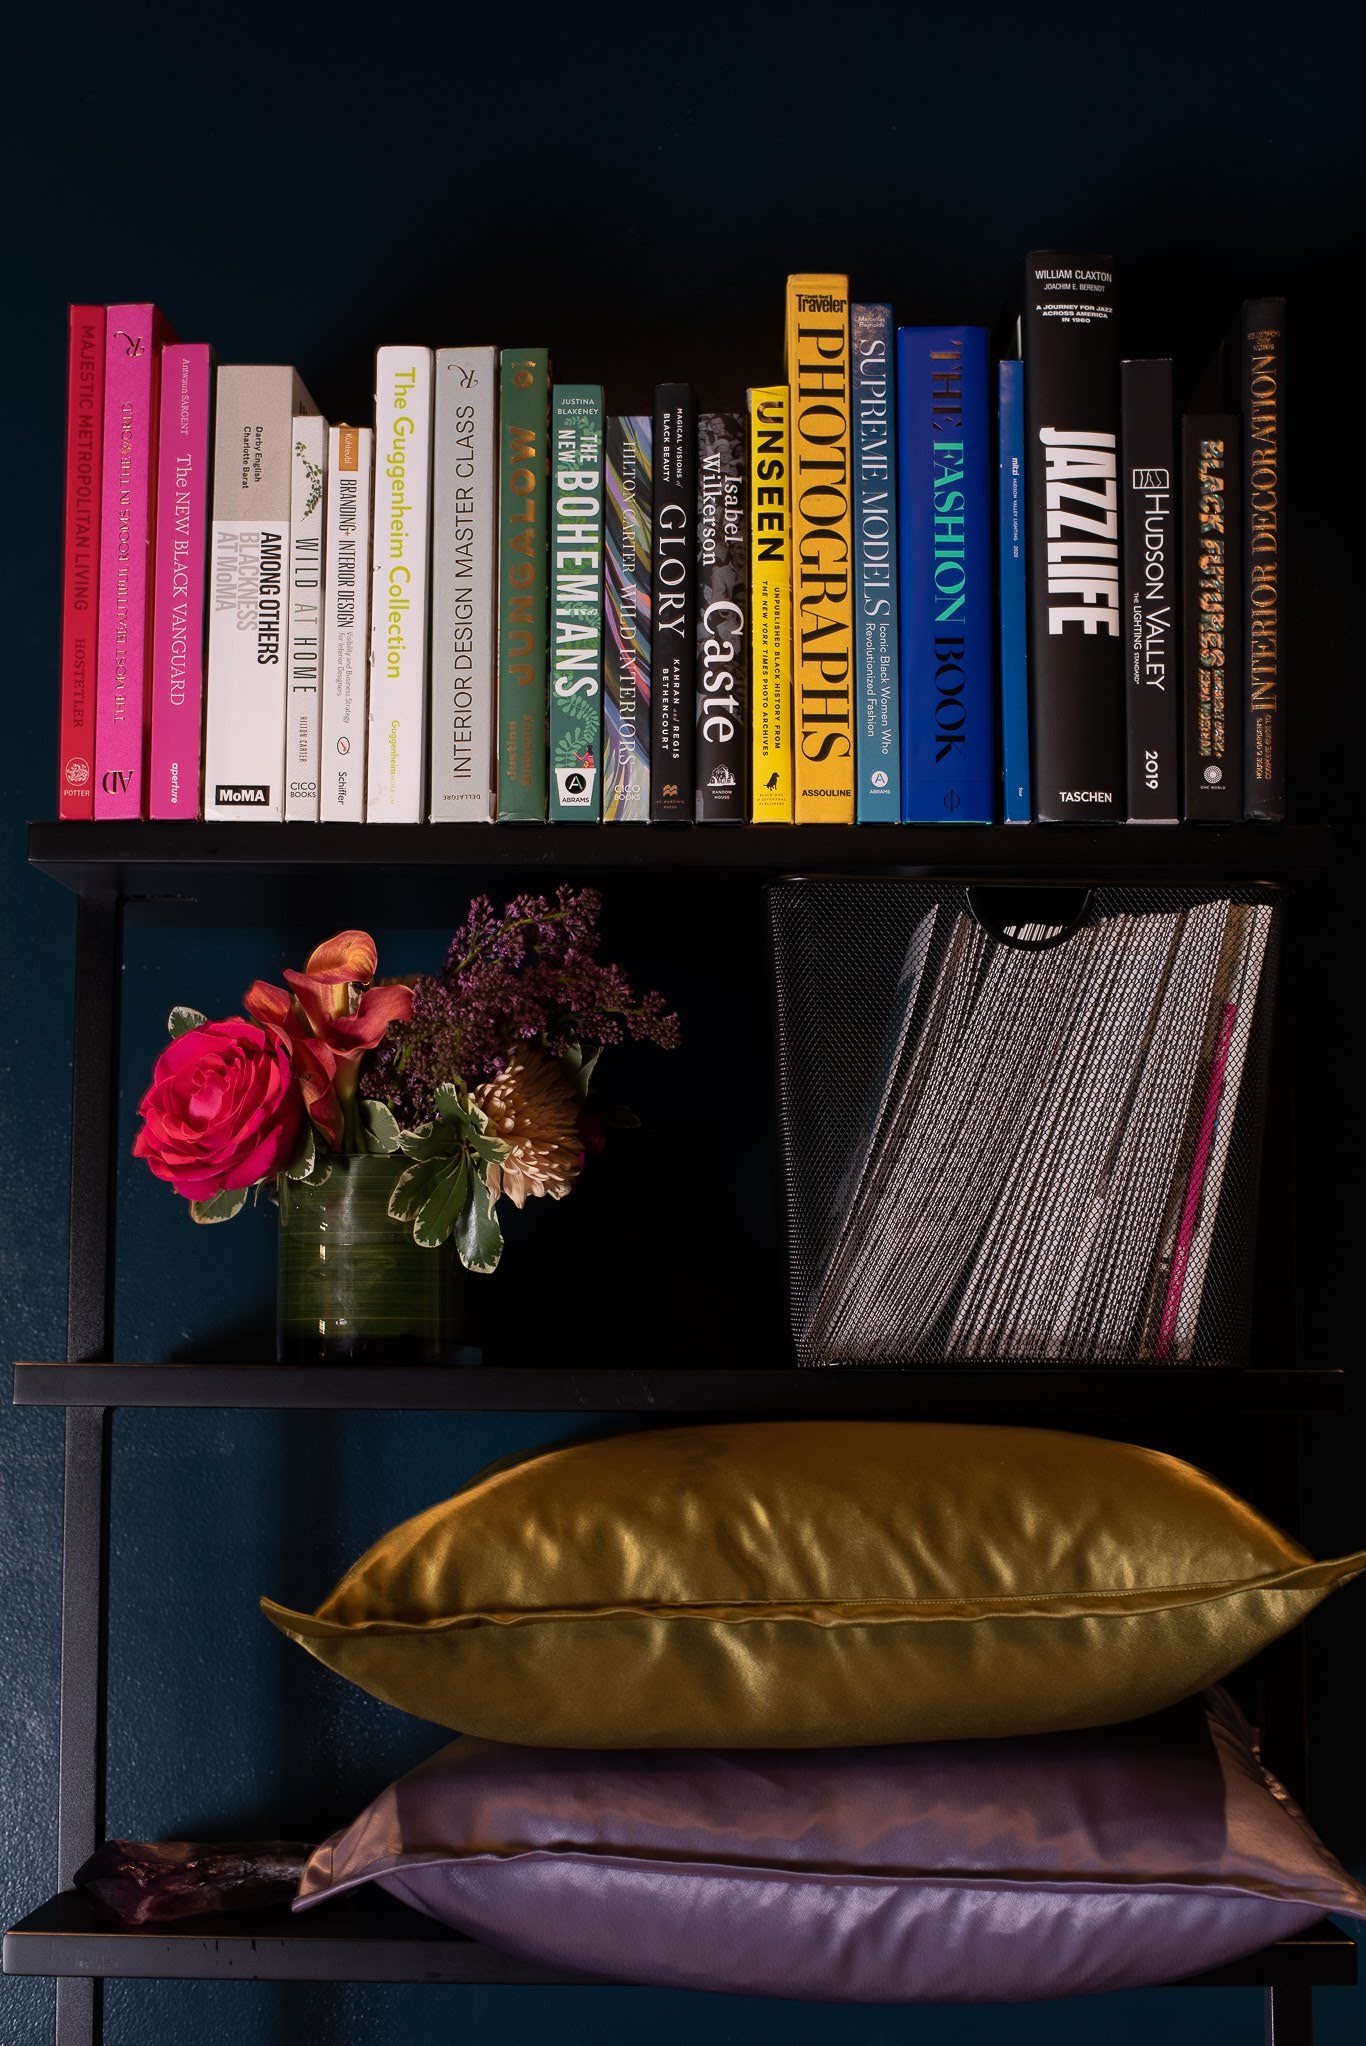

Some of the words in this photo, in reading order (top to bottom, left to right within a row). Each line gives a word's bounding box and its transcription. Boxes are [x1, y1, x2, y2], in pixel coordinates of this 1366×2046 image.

[1034, 269, 1073, 280] WILLIAM
[1074, 269, 1113, 282] CLAXTON
[1043, 283, 1071, 291] JOACHIM
[1072, 283, 1079, 291] E.
[1079, 284, 1105, 292] BERENDT
[795, 294, 847, 313] Traveler
[1075, 311, 1109, 319] AMERICA
[78, 325, 98, 409] MAJESTIC
[181, 358, 191, 394] Antwaun
[393, 366, 416, 409] The
[930, 339, 964, 431] THE
[120, 402, 134, 456] WORLD
[179, 394, 190, 436] SARGENT
[557, 408, 599, 416] BLAKENEY
[662, 412, 672, 444] BLACK
[675, 407, 684, 444] MAGICAL
[859, 339, 887, 481] SUPREME
[242, 426, 252, 465] Charlotte
[254, 426, 264, 451] Darby
[455, 404, 475, 479] CLASS
[557, 429, 576, 464] NEW
[579, 434, 598, 464] THE
[1249, 353, 1278, 556] DECORATION
[75, 414, 94, 543] METROPOLITAN
[119, 456, 132, 487] THE
[175, 453, 193, 488] The
[241, 466, 251, 490] Barat
[251, 453, 263, 482] English
[622, 441, 636, 504] HILTON
[662, 446, 671, 482] BEAUTY
[675, 445, 684, 479] VISIONS
[756, 401, 785, 562] UNSEEN
[1012, 457, 1020, 476] mitzi
[119, 490, 131, 506] IN
[386, 415, 415, 559] Guggenheim
[1199, 440, 1225, 535] BLACK
[174, 490, 190, 536] NEW
[701, 452, 722, 567] Wilkerson
[723, 474, 744, 543] Isabel
[118, 509, 131, 562] ROOMS
[217, 531, 239, 553] AT
[455, 486, 475, 579] MASTER
[621, 508, 637, 574] CARTER
[796, 323, 853, 763] PHOTOGRAPHS
[931, 439, 967, 625] FASHION
[1039, 427, 1120, 638] JAZZLIFE
[172, 539, 191, 598] BLACK
[259, 531, 282, 596] AMONG
[294, 538, 319, 588] WILD
[337, 540, 357, 587] INTERIOR
[505, 425, 537, 686] JUNGALOW
[657, 503, 688, 639] GLORY
[861, 491, 891, 617] MODELS
[74, 554, 89, 611] LIVING
[215, 556, 237, 612] MoMA
[236, 532, 261, 632] BLACKNESS
[555, 470, 600, 697] BOHEMIANS
[293, 603, 318, 625] AT
[336, 590, 356, 629] DESIGN
[388, 565, 411, 679] Collection
[619, 583, 638, 641] WILD
[1198, 538, 1226, 668] FUTURES
[257, 599, 281, 665] OTHERS
[337, 632, 346, 642] for
[344, 631, 354, 656] Visibility
[454, 586, 474, 670] DESIGN
[879, 622, 890, 653] Iconic
[1133, 605, 1142, 650] LIGHTING
[1249, 562, 1278, 713] INTERIOR
[115, 649, 127, 690] MOST
[169, 602, 188, 706] VANGUARD
[292, 637, 318, 693] HOME
[337, 643, 346, 668] Interior
[344, 658, 354, 670] and
[702, 600, 745, 744] Caste
[865, 622, 877, 696] Revolutionized
[880, 655, 891, 684] Black
[73, 638, 87, 728] HOSTETLER
[335, 670, 345, 697] Designers
[344, 671, 354, 697] Business
[673, 658, 681, 706] KAHRAN
[934, 636, 967, 765] BOOK
[114, 694, 127, 724] THE
[298, 716, 308, 737] HILTON
[342, 698, 353, 724] Strategy
[618, 647, 638, 767] INTERIORS
[661, 667, 670, 751] BETHENCOURT
[866, 697, 878, 738] Fashion
[881, 685, 891, 727] Women
[1264, 714, 1272, 724] TO
[454, 676, 473, 779] INTERIOR
[672, 725, 681, 760] REGIS
[881, 728, 892, 755] Who
[1264, 725, 1272, 745] GUIDE
[298, 739, 308, 763] CARTER
[1145, 749, 1159, 790] 2019
[1264, 746, 1272, 780] COMPLETE
[64, 789, 91, 798] POTTER
[102, 770, 134, 795] AD
[170, 762, 181, 804] aperture
[219, 788, 265, 803] MoMA
[290, 782, 317, 791] CICO
[290, 791, 317, 799] BOOKS
[337, 771, 349, 806] Schiffer
[614, 784, 642, 793] CICO
[801, 789, 852, 798] ASSOULINE
[1058, 791, 1113, 803] TASCHEN
